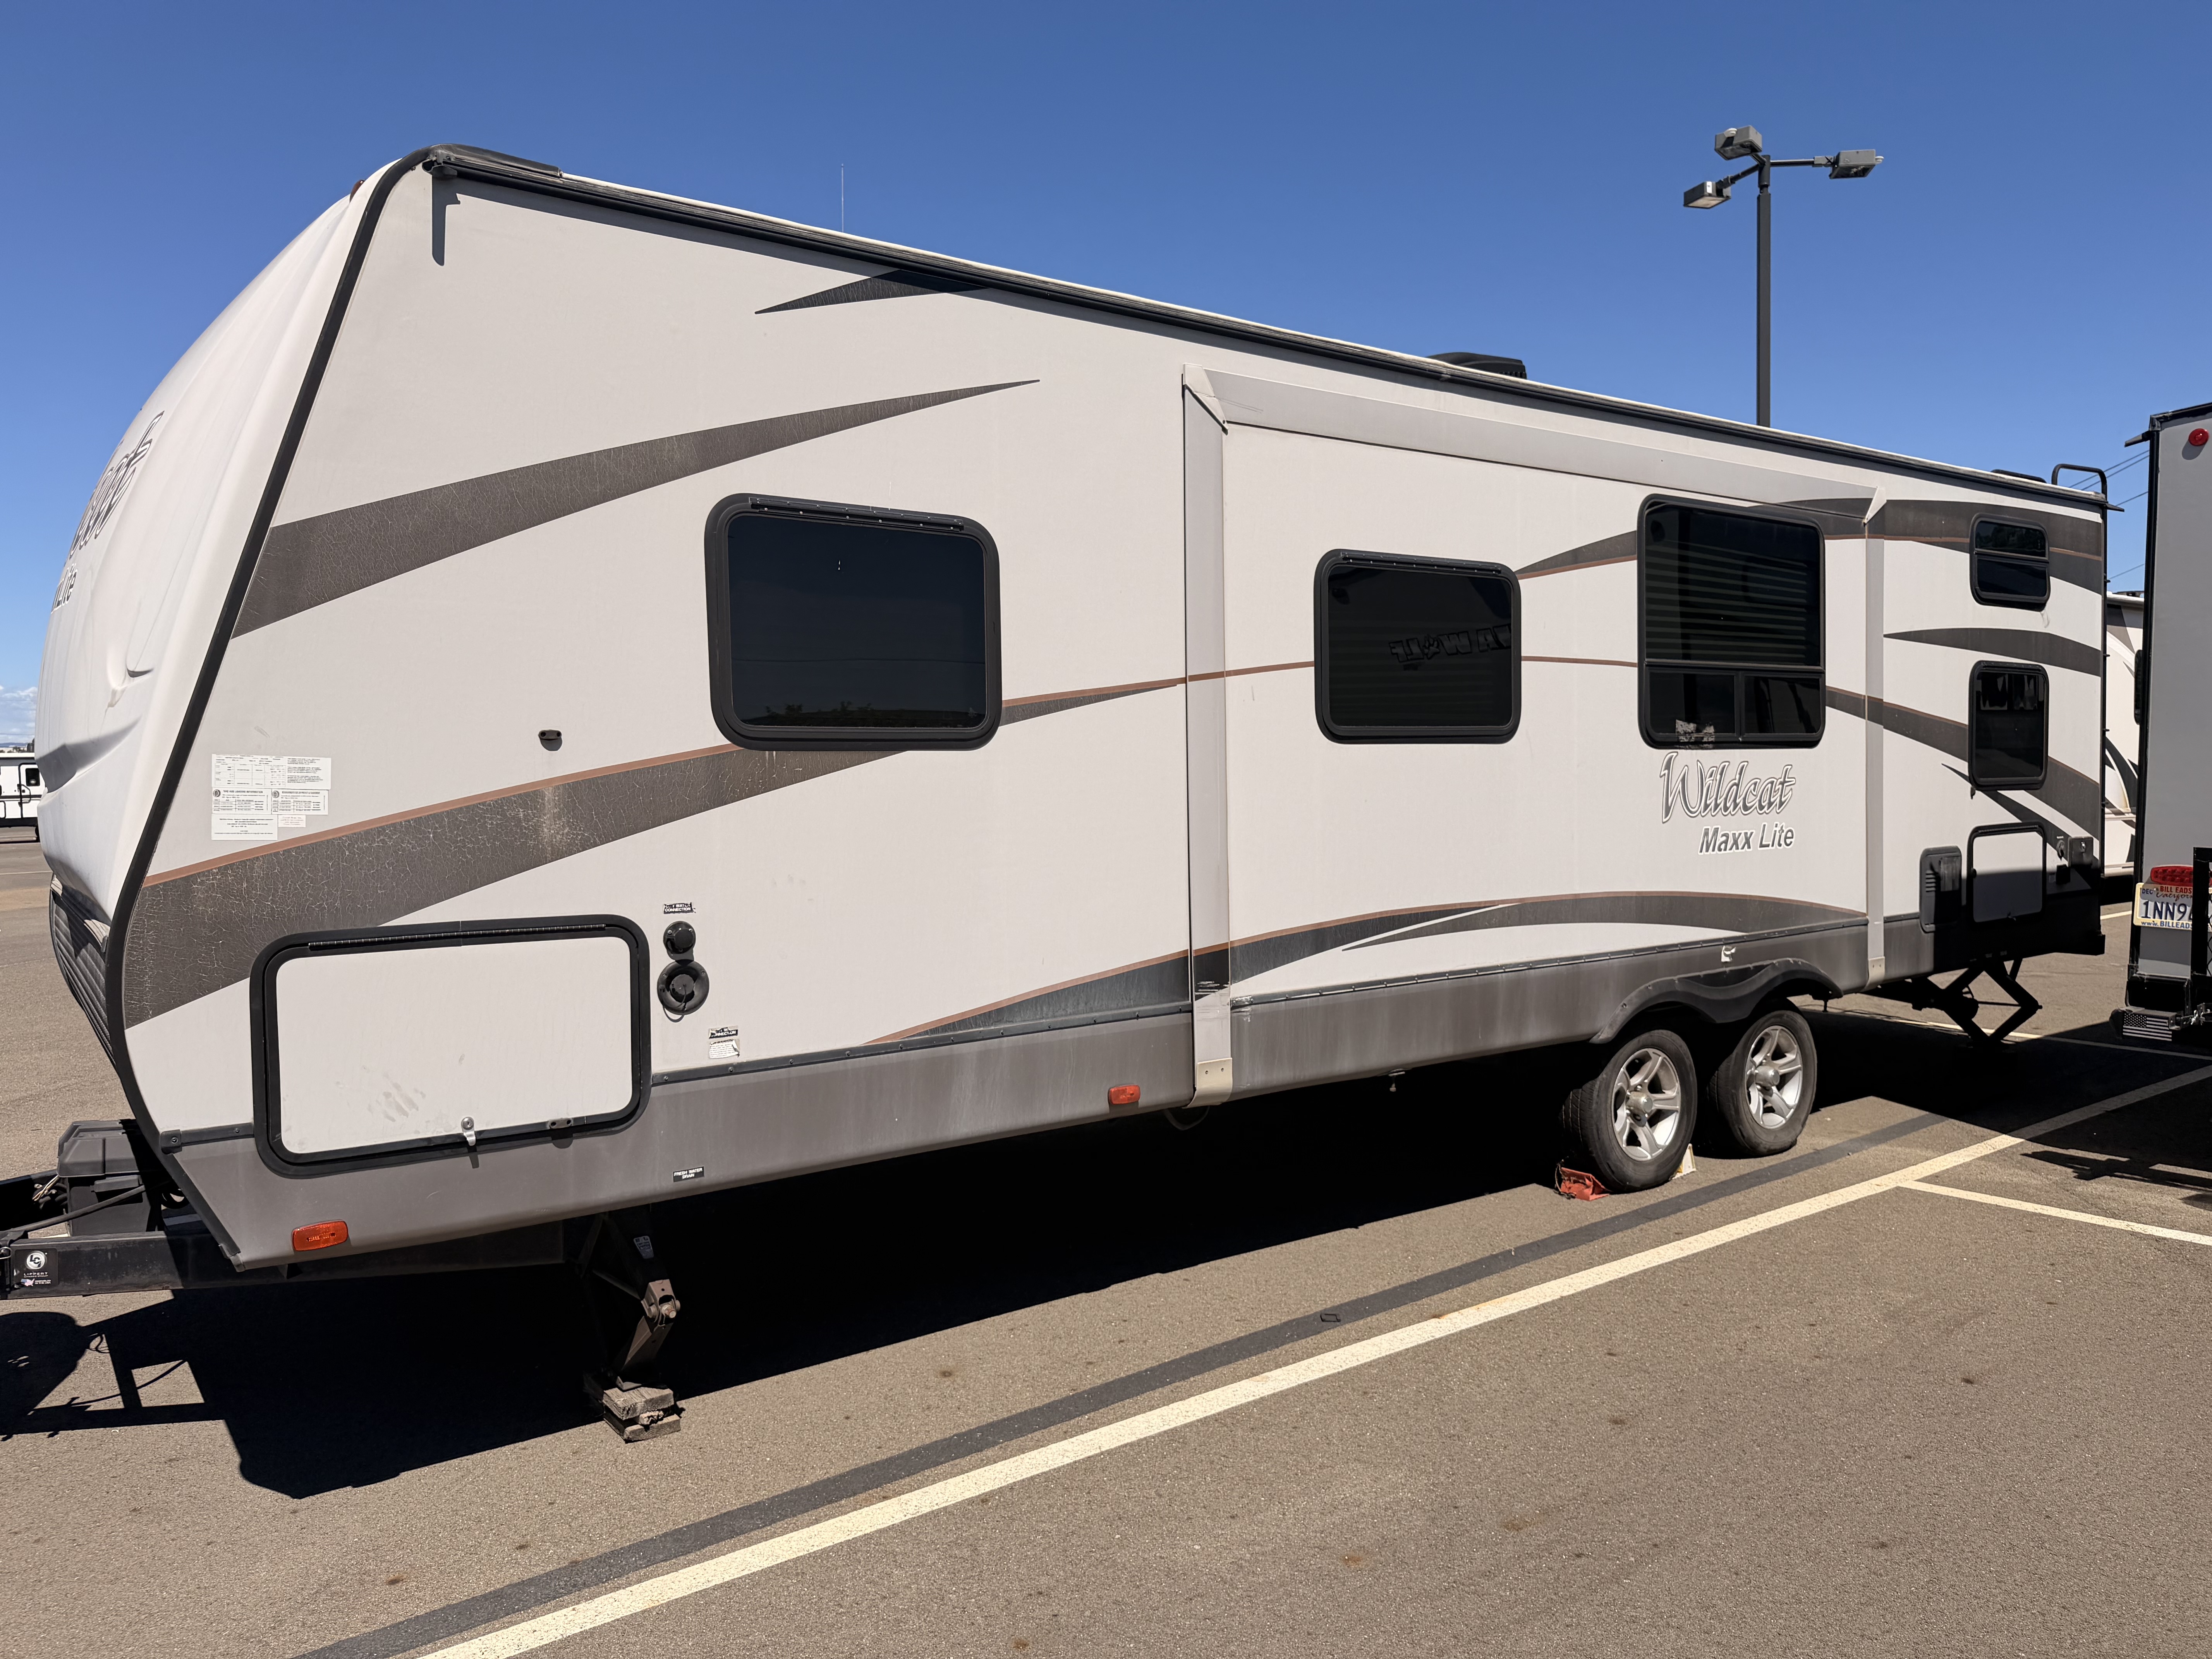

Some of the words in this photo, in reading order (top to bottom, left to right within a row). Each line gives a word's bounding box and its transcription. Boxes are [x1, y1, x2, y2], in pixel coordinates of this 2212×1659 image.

[1660, 752, 1796, 824] Wildcat
[1698, 826, 1755, 855] Maxx
[1758, 822, 1796, 850] Lite
